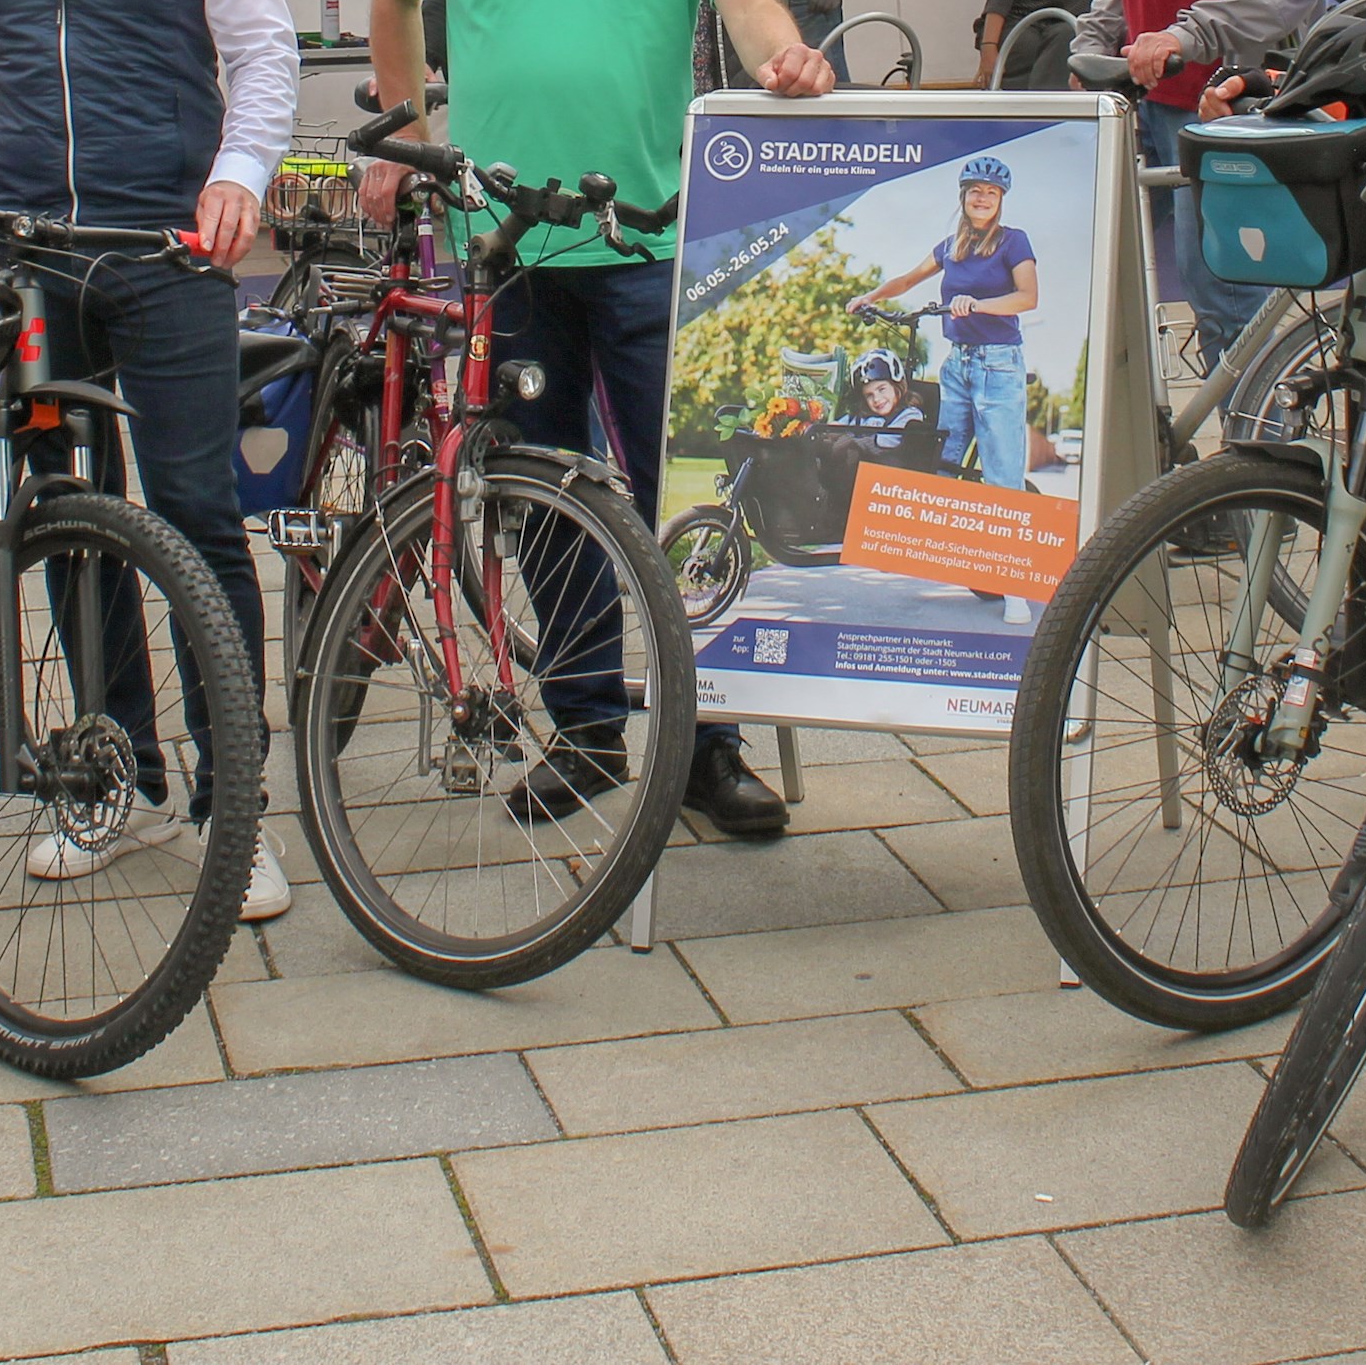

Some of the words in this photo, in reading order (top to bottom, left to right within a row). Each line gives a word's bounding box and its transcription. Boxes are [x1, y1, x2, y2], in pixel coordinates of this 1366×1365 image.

[760, 141, 922, 163] STADTRADELN
[760, 164, 791, 173] Radeln
[793, 165, 806, 174] für
[808, 166, 822, 174] ein
[824, 166, 849, 176] gutes
[850, 165, 876, 175] Klima
[685, 222, 790, 302] 06.05.-26.05.24
[871, 482, 1031, 525] Auftaktveranstaltung
[23, 520, 131, 547] SCHWALBE
[868, 501, 891, 516] am
[894, 504, 916, 520] 06.
[920, 509, 947, 526] Mai
[950, 515, 984, 533] 2024
[987, 524, 1012, 538] um
[1016, 528, 1033, 542] 15
[1037, 530, 1065, 548] Uhr
[863, 526, 923, 546] kostenloser
[925, 537, 1033, 568] Rad-Sicherheitscheck
[861, 540, 877, 552] auf
[880, 544, 903, 556] dem
[905, 547, 971, 570] Rathausplatz
[973, 562, 993, 574] von
[995, 564, 1008, 577] 12
[1010, 567, 1025, 580] bis
[1028, 571, 1041, 583] 18
[732, 644, 750, 654] App:
[837, 632, 901, 644] Ansprechpartner
[903, 637, 911, 645] in
[912, 638, 954, 648] Neumarkt:
[837, 641, 907, 655] Stadtplanungsamt
[908, 646, 920, 655] der
[922, 647, 943, 656] Stadt
[944, 649, 983, 660] Neumarkt
[837, 651, 852, 661] Tel.:
[853, 652, 876, 662] 09181
[878, 654, 913, 664] 255-1501
[915, 657, 933, 665] oder
[935, 658, 957, 667] -1505
[835, 661, 856, 670] Infos
[857, 662, 873, 671] und
[874, 663, 922, 676] Anmeldung
[923, 667, 948, 676] unter:
[950, 669, 1022, 682] www.stadtradeln
[947, 698, 1015, 715] NEUMAR
[48, 1034, 92, 1050] SAM
